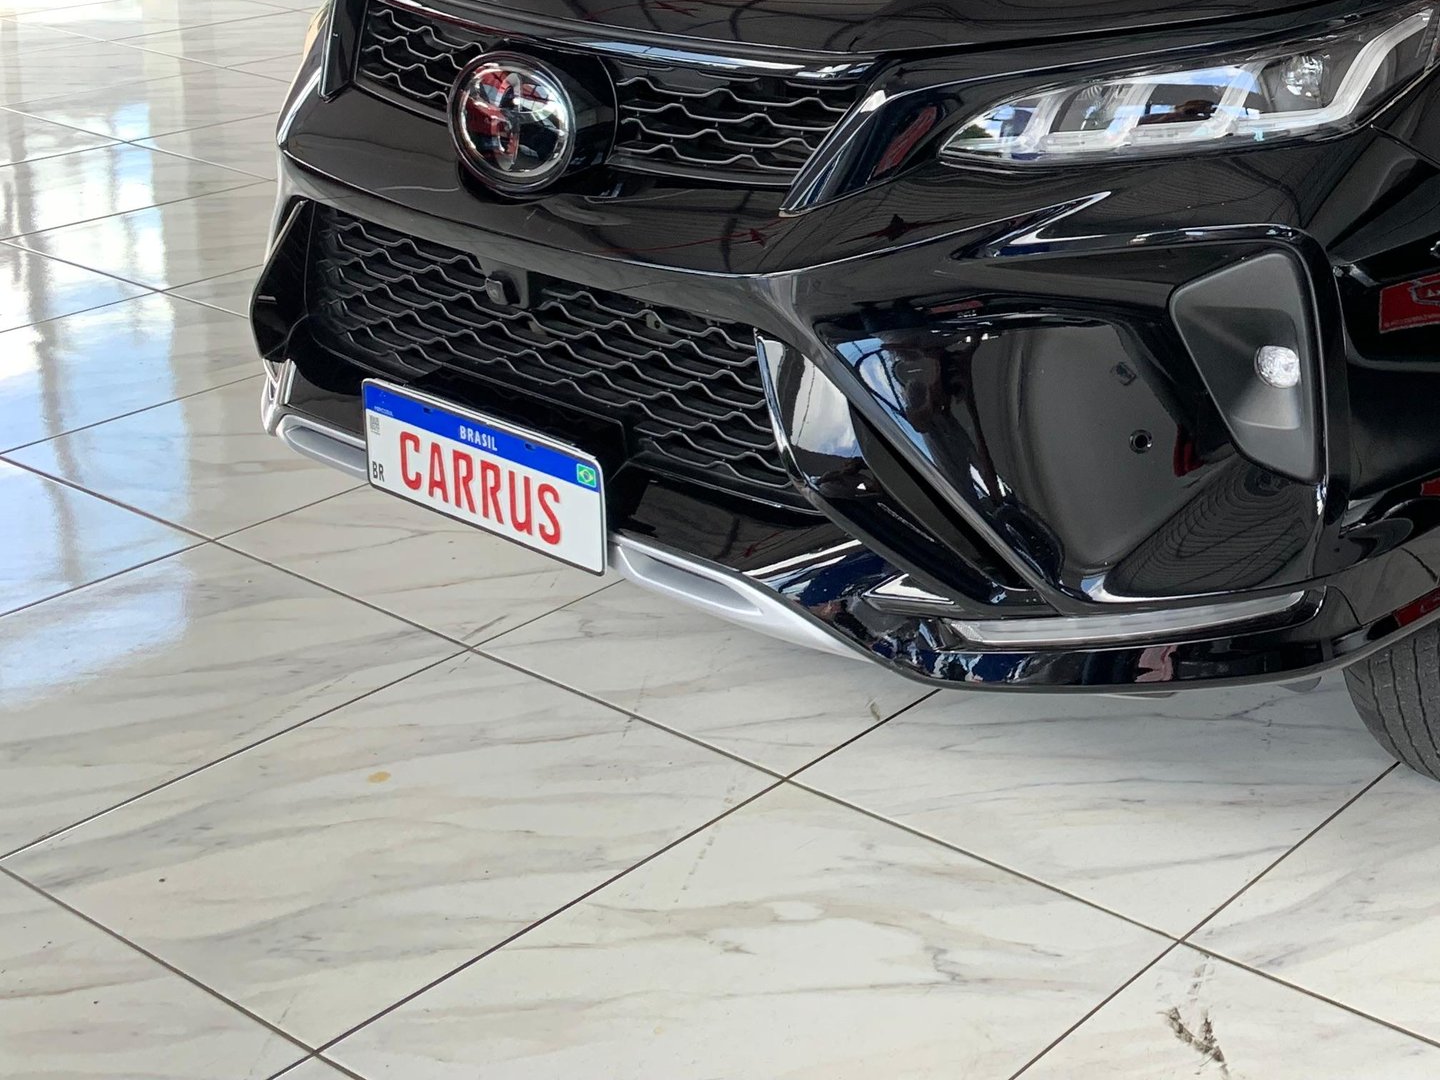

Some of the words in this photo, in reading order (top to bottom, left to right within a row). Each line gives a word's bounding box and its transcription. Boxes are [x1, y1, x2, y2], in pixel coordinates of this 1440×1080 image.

[459, 425, 498, 452] BRASIL
[372, 460, 385, 483] BR
[399, 431, 562, 546] CARRUS
